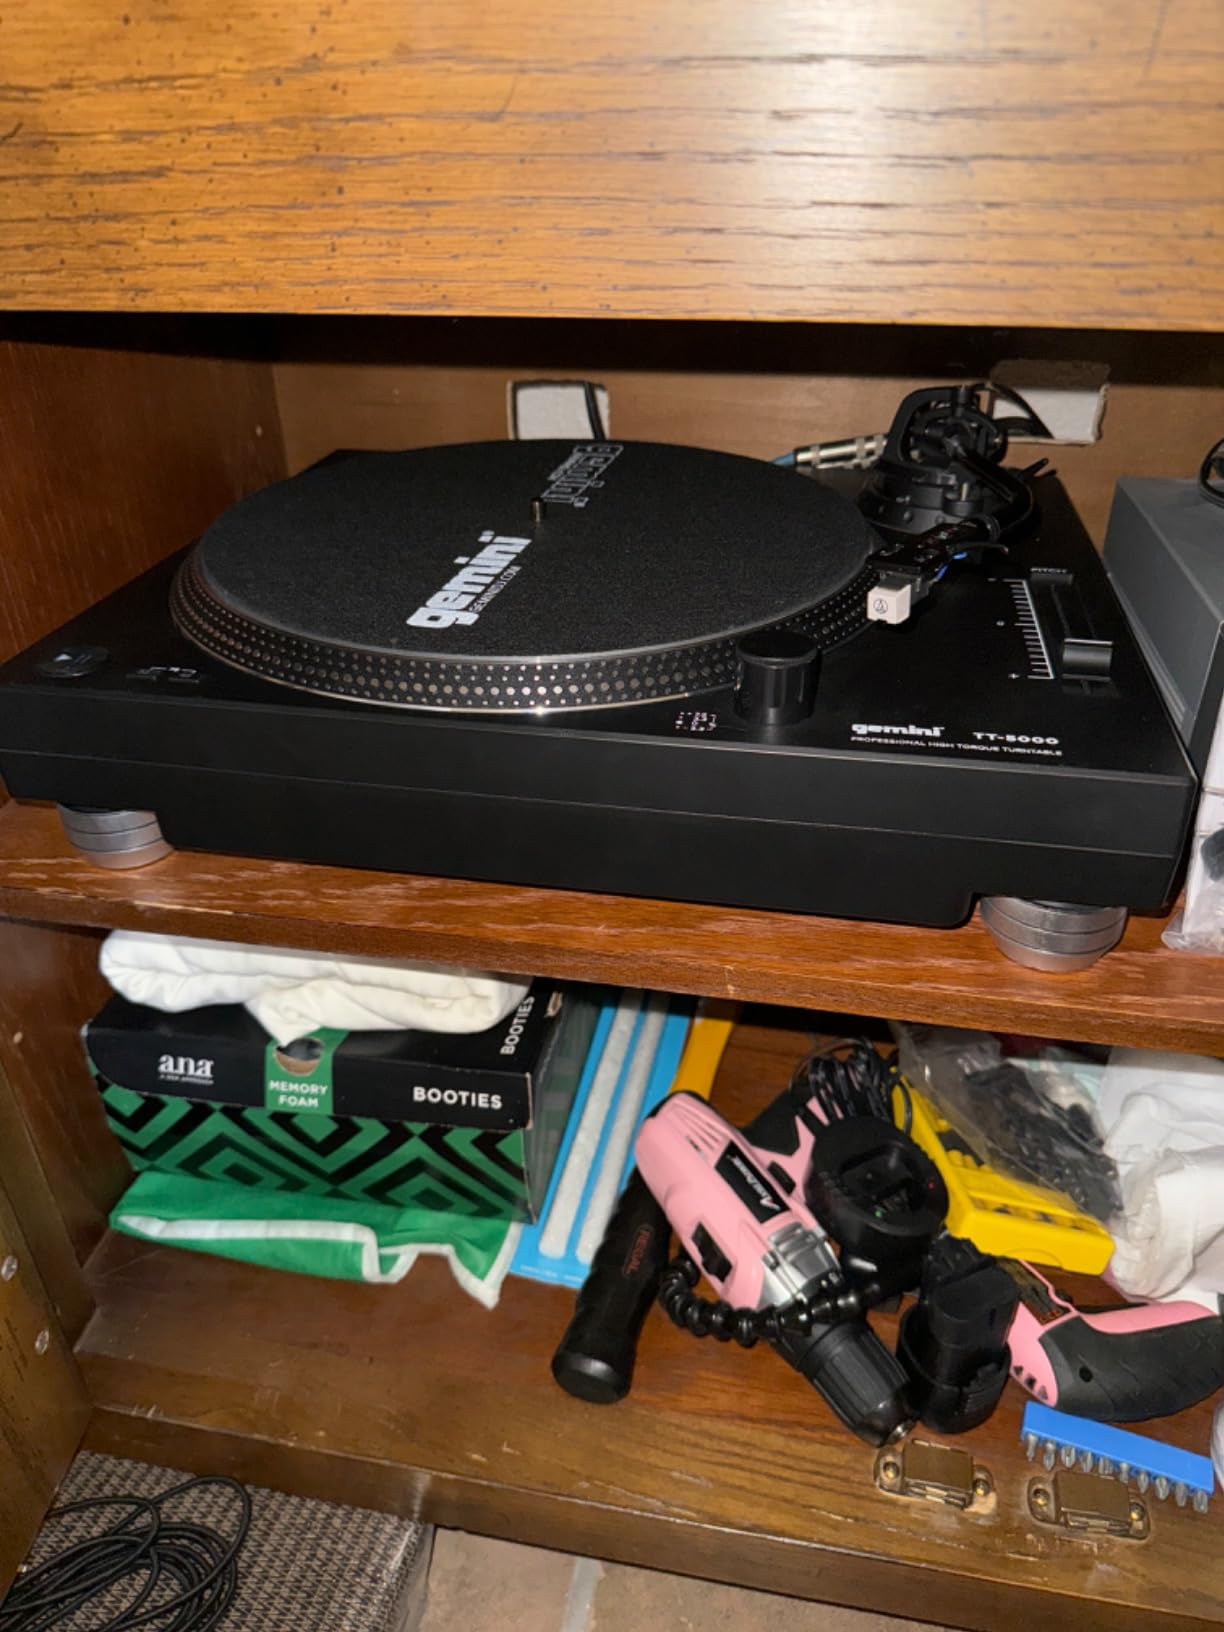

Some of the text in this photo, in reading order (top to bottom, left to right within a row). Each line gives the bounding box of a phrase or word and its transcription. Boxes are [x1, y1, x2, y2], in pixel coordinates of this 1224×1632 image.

[406, 530, 532, 629] gemini
[851, 723, 1060, 745] gemini TT-5000
[499, 996, 535, 1055] BOOTIES
[158, 1054, 214, 1078] ana
[269, 1079, 328, 1095] MEMORY
[412, 1086, 503, 1110] BOOTIES
[278, 1094, 319, 1108] FOAM
